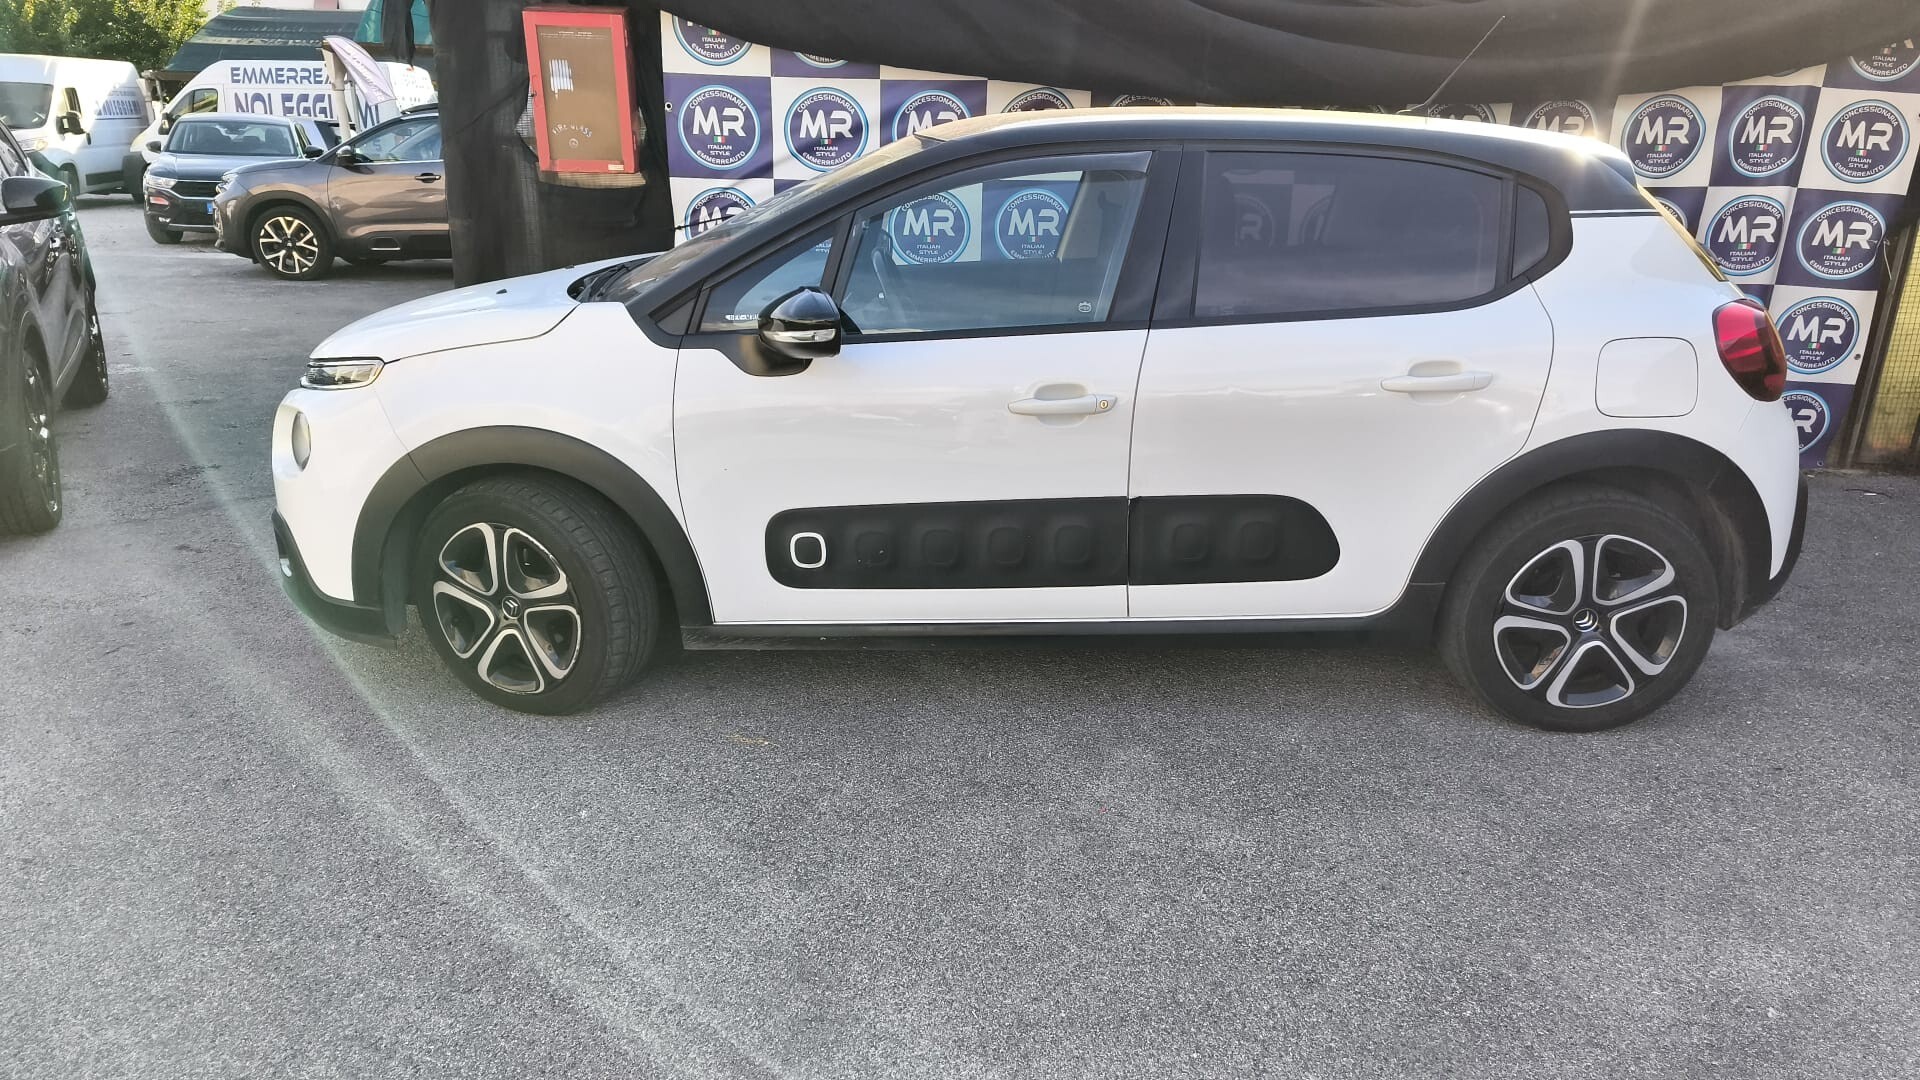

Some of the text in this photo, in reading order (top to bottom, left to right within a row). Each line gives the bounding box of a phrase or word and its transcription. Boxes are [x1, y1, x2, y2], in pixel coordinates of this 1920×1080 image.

[691, 43, 740, 58] EMMERREAUTO
[230, 67, 335, 84] EMMERRE
[1859, 61, 1908, 76] EMMERREAUTO
[689, 90, 747, 112] CONCESSIONARIA
[797, 93, 856, 115] CONCESSIONARIA
[905, 95, 962, 116] CONCESSIONARIA
[1638, 101, 1694, 121] CONCESSIONARIA
[1745, 100, 1799, 120] CONCESSIONARIA
[692, 106, 747, 137] MR
[800, 109, 854, 138] MR
[1840, 106, 1899, 127] CONCESSIONARIA
[1635, 116, 1690, 145] MR
[1740, 115, 1795, 144] MR
[1835, 120, 1893, 151] MR
[696, 150, 746, 165] EMMERREAUTO
[802, 151, 852, 167] EMMERREAUTO
[1634, 158, 1683, 172] EMMERREAUTO
[1737, 156, 1787, 172] EMMERREAUTO
[1834, 162, 1885, 177] EMMERREAUTO
[1007, 193, 1063, 213] CONCESSIONARIA
[1721, 201, 1781, 220] CONCESSIONARIA
[903, 208, 955, 236] MR
[1008, 208, 1060, 236] MR
[1816, 206, 1878, 226] CONCESSIONARIA
[1718, 216, 1777, 243] MR
[1811, 219, 1873, 249] MR
[906, 250, 954, 263] EMMERREAUTO
[1718, 256, 1770, 270] EMMERREAUTO
[1809, 260, 1864, 275] EMMERREAUTO
[1791, 303, 1852, 323] CONCESSIONARIA
[1786, 314, 1846, 344] MR
